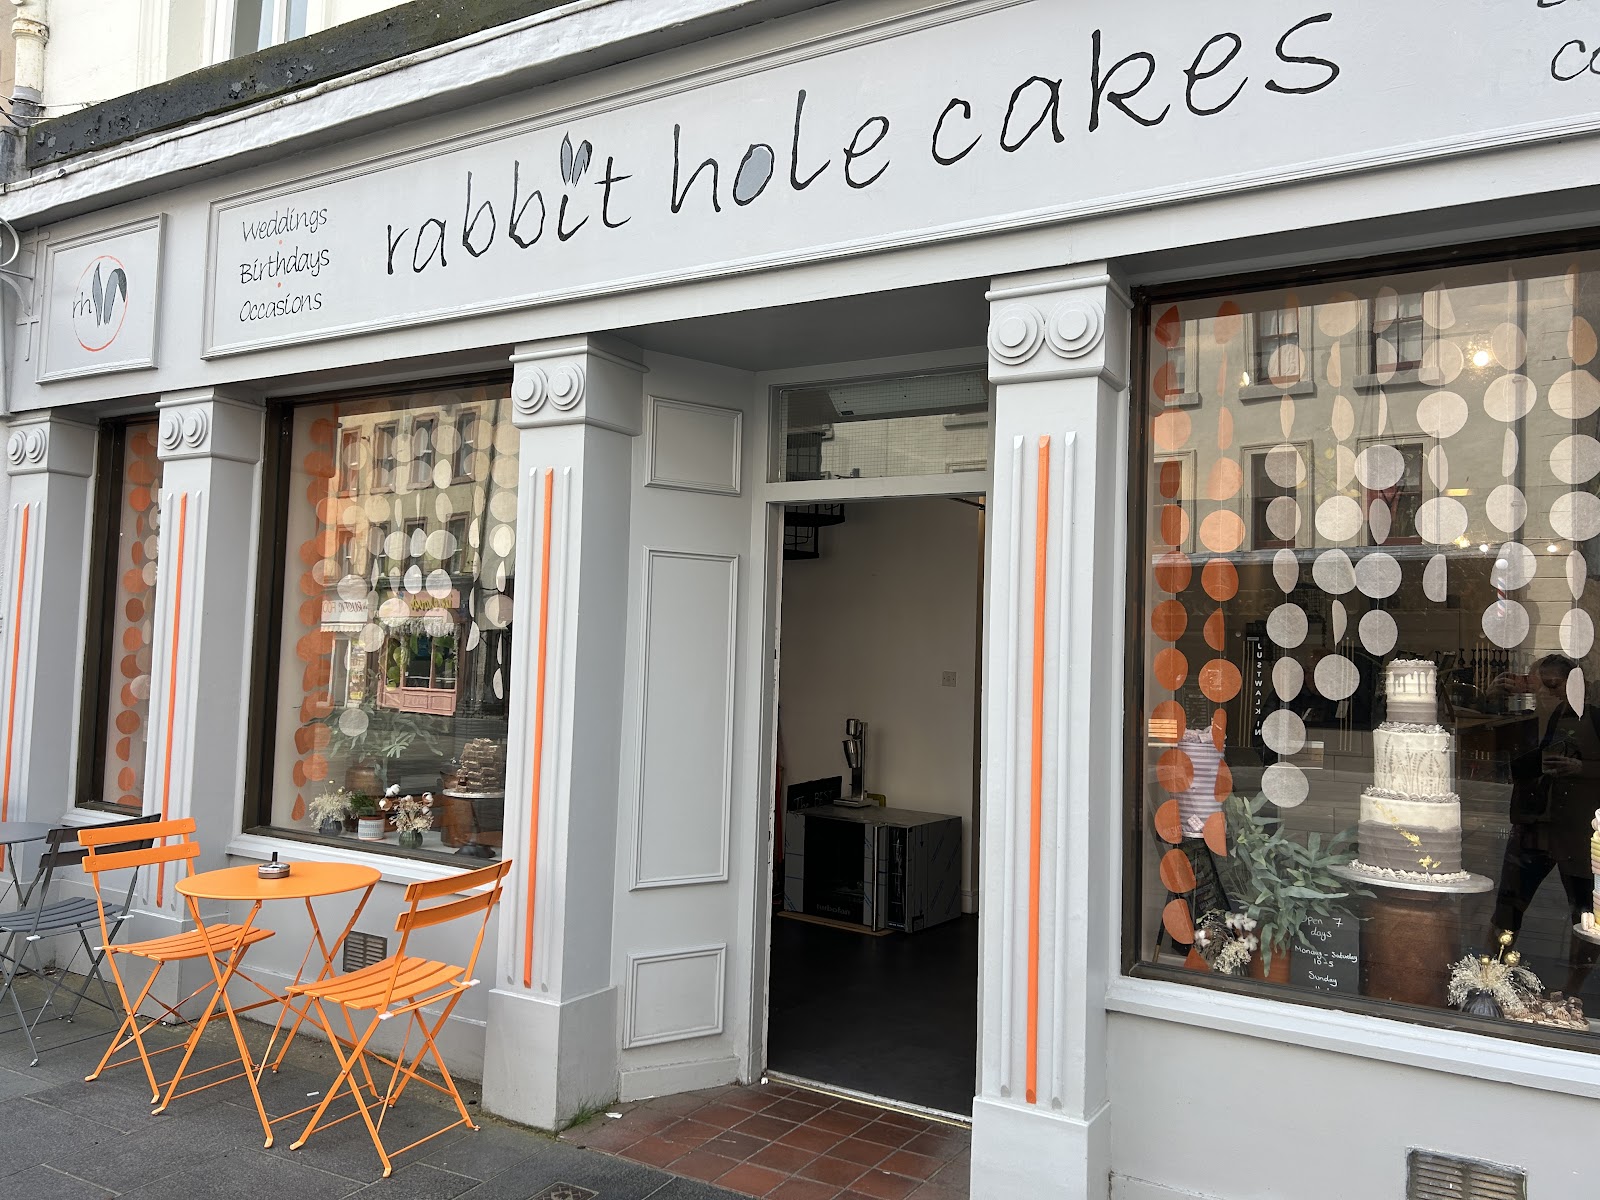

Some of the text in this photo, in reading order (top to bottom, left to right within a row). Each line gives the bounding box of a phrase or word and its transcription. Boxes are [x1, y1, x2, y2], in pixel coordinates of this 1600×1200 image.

[387, 13, 1340, 276] rabbit hole cakes
[242, 206, 328, 242] Weddings
[239, 246, 330, 285] Birthdays
[239, 292, 322, 322] Occasions
[1331, 917, 1344, 928] 7
[1310, 927, 1332, 942] days
[1331, 951, 1358, 963] Saturday
[1308, 970, 1338, 987] Sunday
